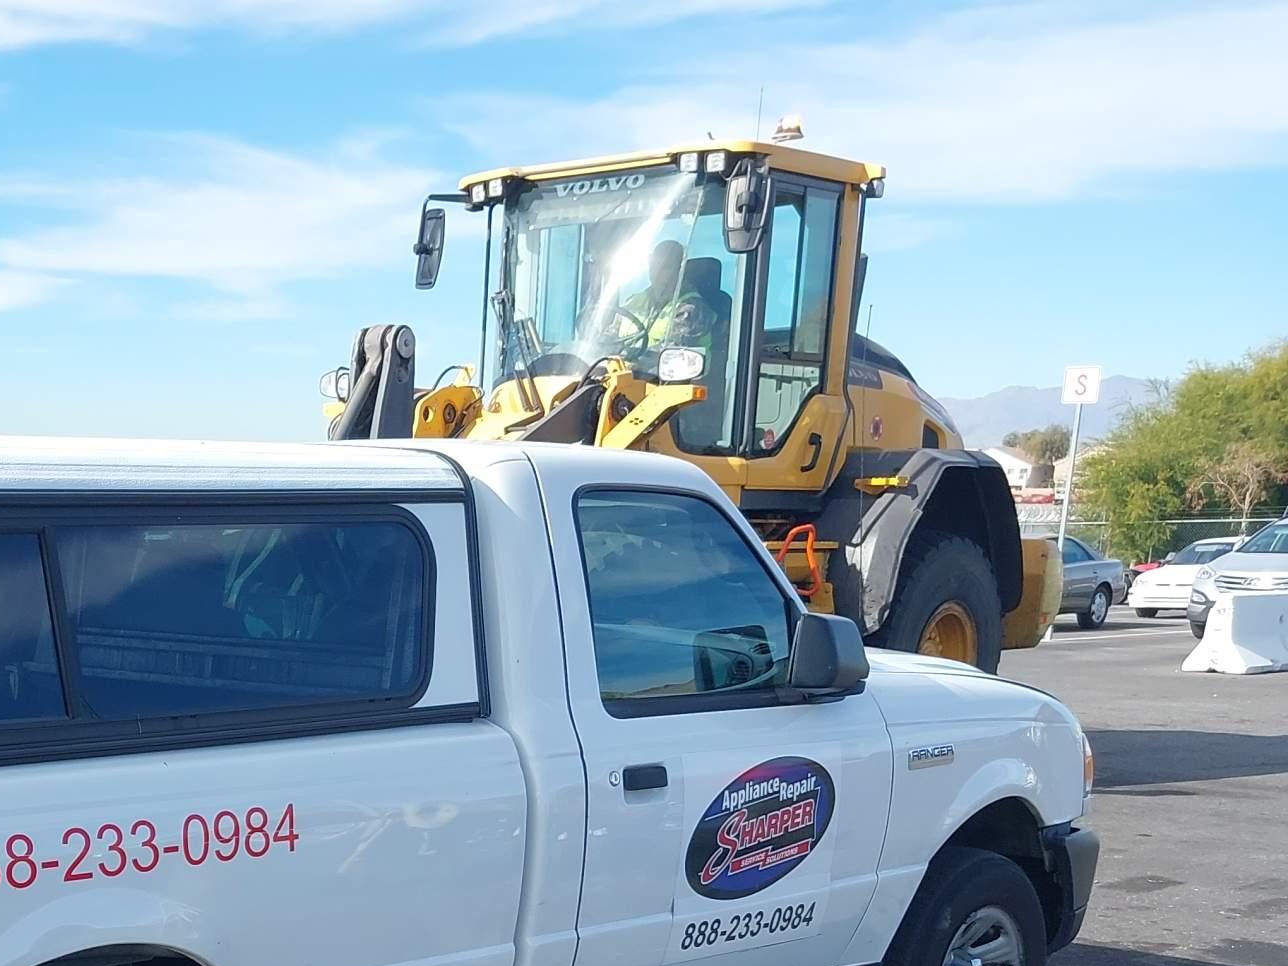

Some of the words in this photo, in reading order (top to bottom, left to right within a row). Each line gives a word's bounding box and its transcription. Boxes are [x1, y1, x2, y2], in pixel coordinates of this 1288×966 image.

[555, 174, 645, 198] VOLVO
[1074, 374, 1088, 396] S
[910, 744, 954, 761] RANGER
[722, 777, 780, 812] Appliance
[779, 773, 817, 801] Repair
[699, 799, 815, 885] SHARPER
[740, 852, 766, 868] SERVICE
[680, 901, 816, 950] 888-233-0984
